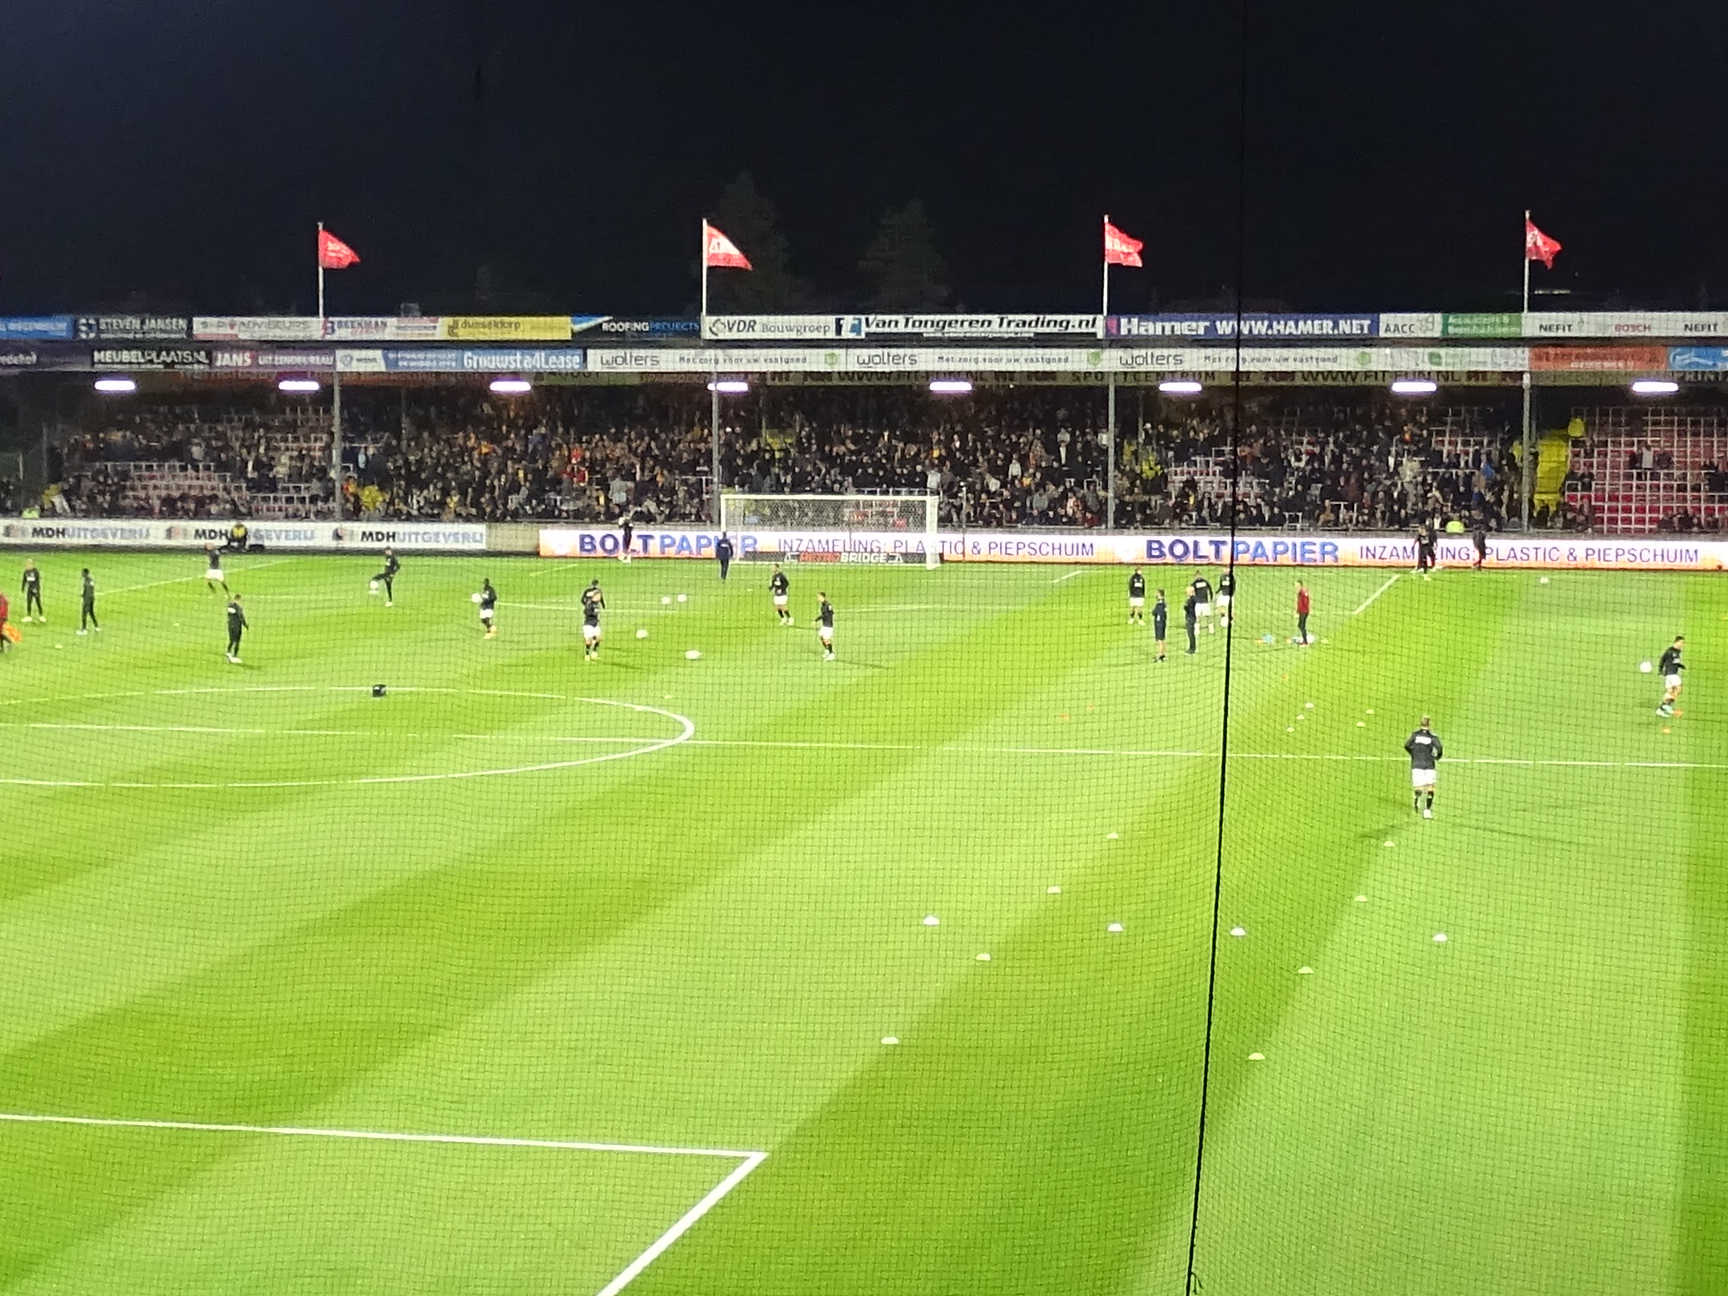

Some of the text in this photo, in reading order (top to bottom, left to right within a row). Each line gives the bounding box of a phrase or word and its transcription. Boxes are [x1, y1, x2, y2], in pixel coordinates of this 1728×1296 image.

[98, 318, 141, 331] STEVEN
[143, 318, 188, 331] JANSEN
[725, 319, 831, 337] VDR Bouwgroep
[864, 316, 1098, 331] Van Tongeren Trading.nl
[1120, 317, 1372, 336] Hamer WWW.HAMER.NET
[1538, 323, 1572, 333] NEFIT
[1614, 323, 1652, 333] BOSCH
[1683, 323, 1719, 333] NEFIT
[93, 350, 210, 364] MEUBELPLAATS.NL
[215, 352, 252, 367] JANS
[600, 352, 660, 367] wolters
[856, 352, 918, 367] wolters
[1119, 352, 1184, 367] wolters
[893, 539, 965, 556] PLATIC
[970, 542, 982, 555] &
[987, 540, 1095, 557] PIEPSCHUIM
[1145, 538, 1339, 564] BOLTPAPIER
[1566, 547, 1580, 563] &
[1584, 546, 1699, 565] PIEPSCHUIM
